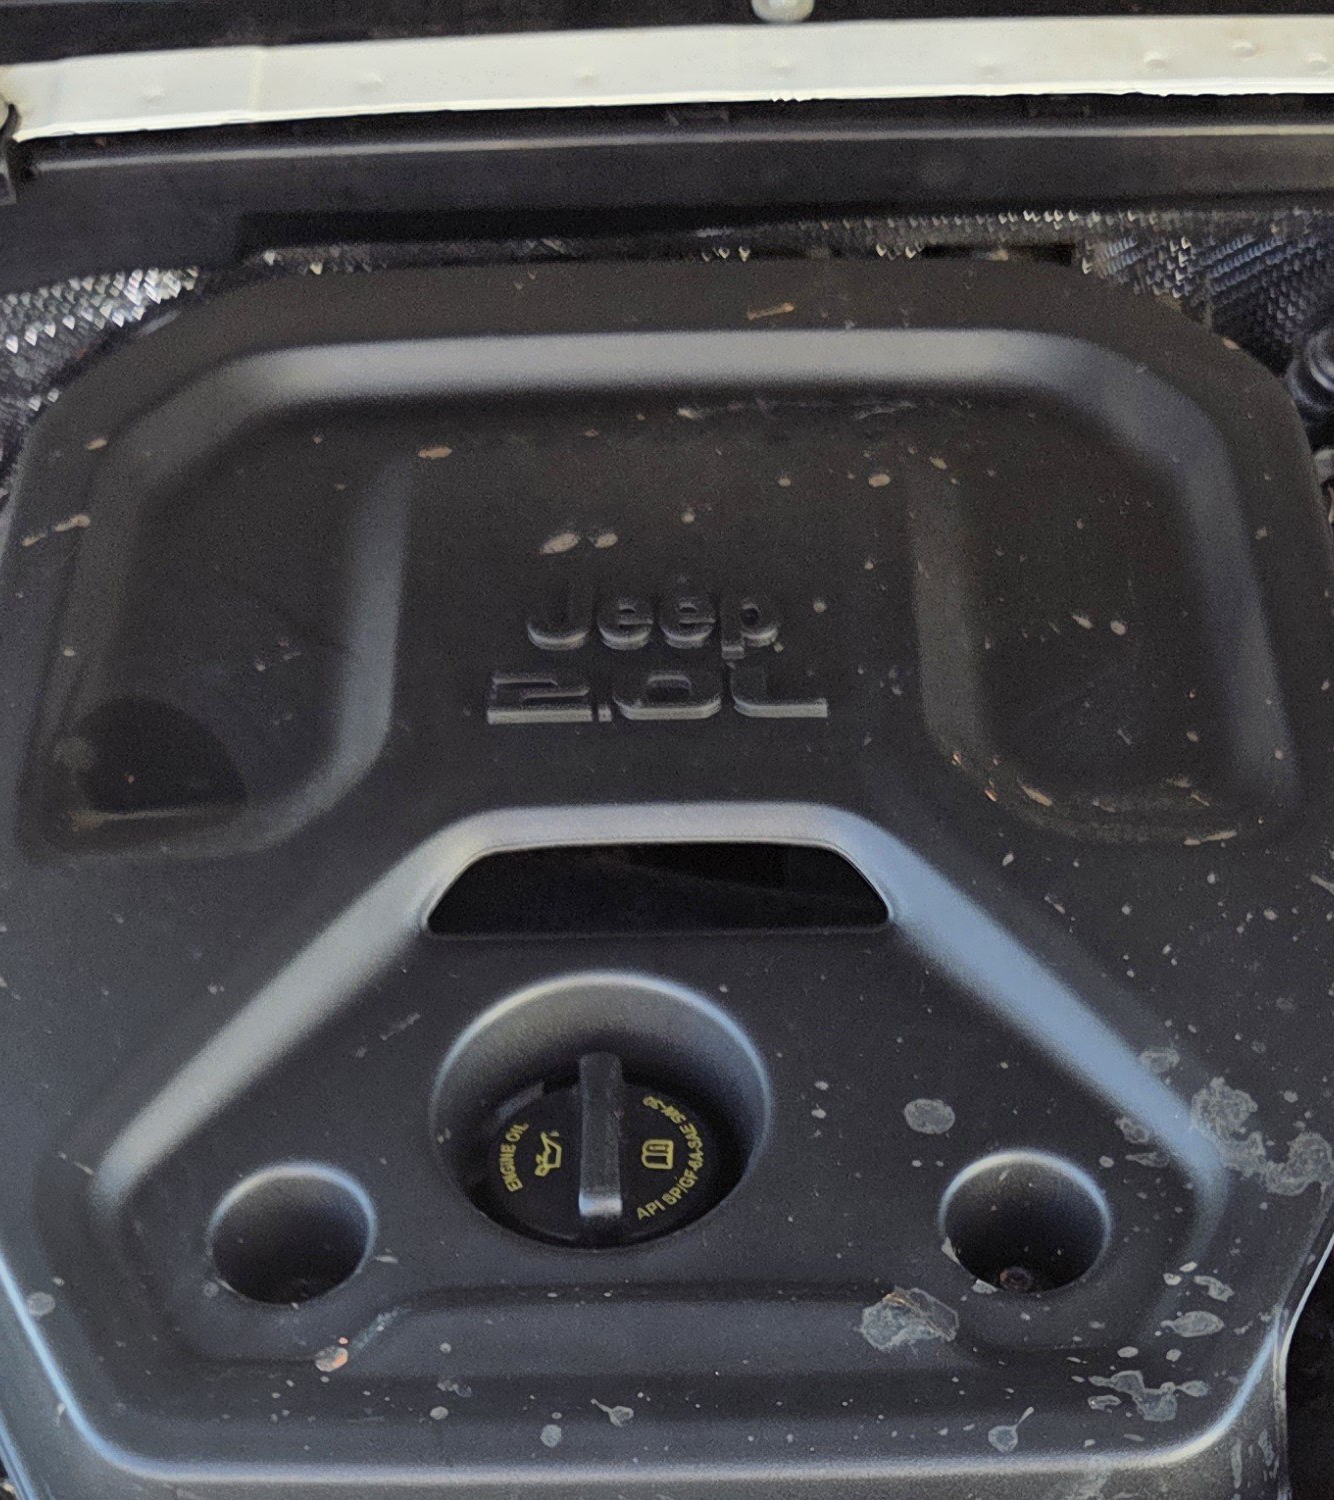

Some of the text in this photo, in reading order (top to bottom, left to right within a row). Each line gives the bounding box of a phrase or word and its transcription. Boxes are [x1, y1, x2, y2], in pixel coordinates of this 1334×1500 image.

[525, 584, 781, 661] Jeep
[487, 668, 829, 725] 2.0L
[499, 1122, 530, 1192] ENGINE OIL
[636, 1199, 666, 1221] API
